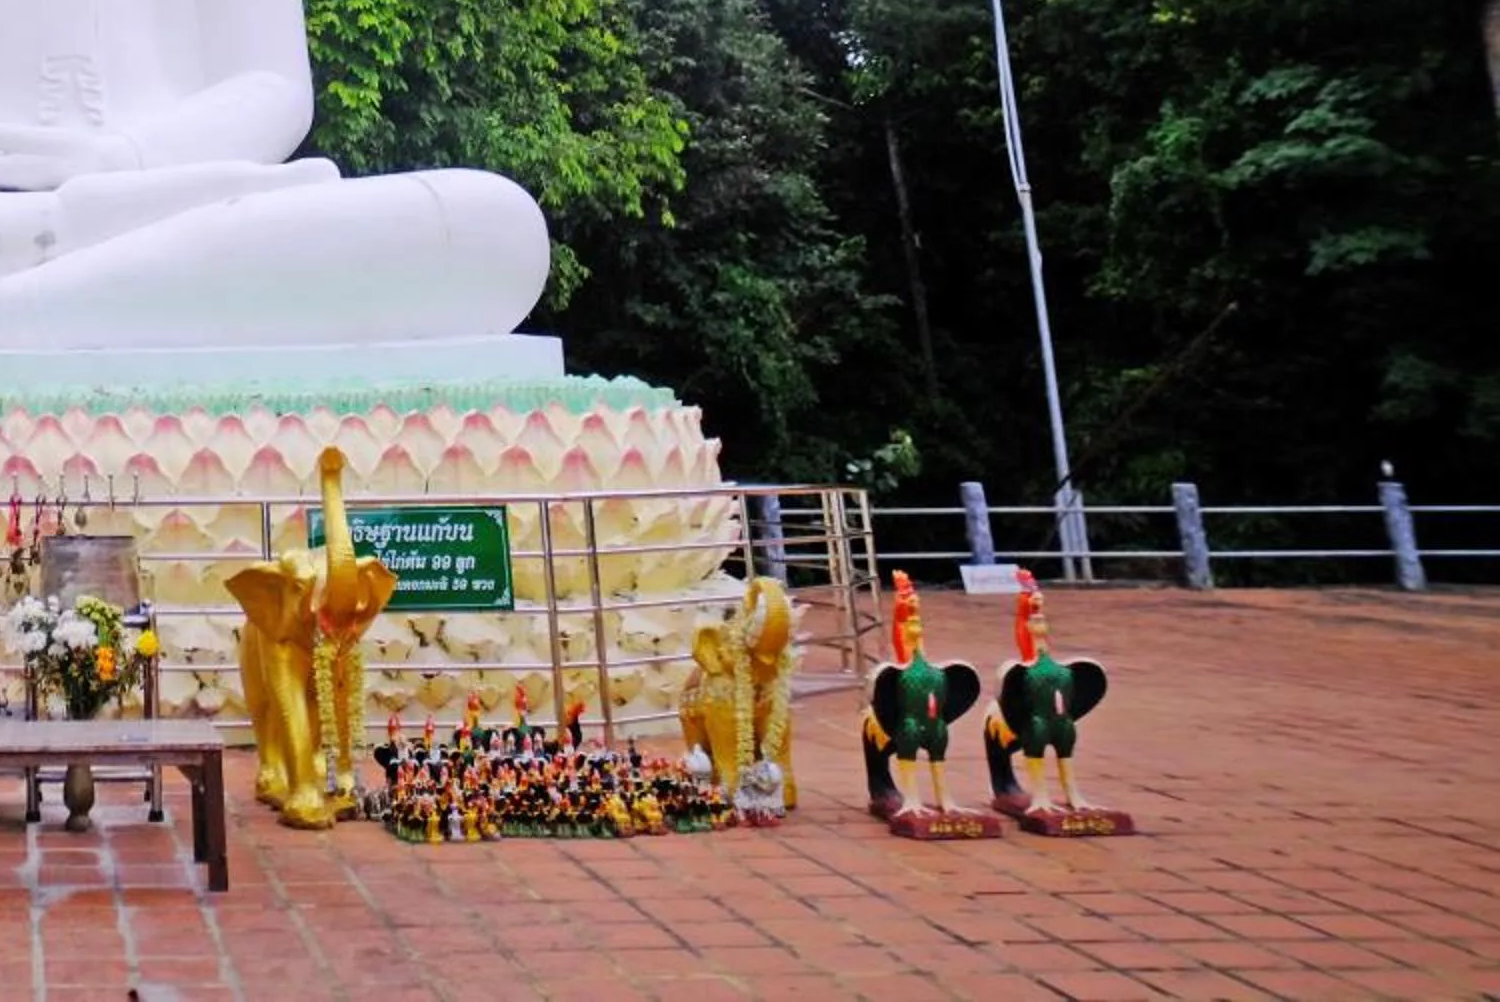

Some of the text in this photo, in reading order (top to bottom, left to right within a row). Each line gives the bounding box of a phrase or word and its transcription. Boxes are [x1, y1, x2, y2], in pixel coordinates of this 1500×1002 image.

[348, 515, 475, 549] ธิษฐานแก้บน
